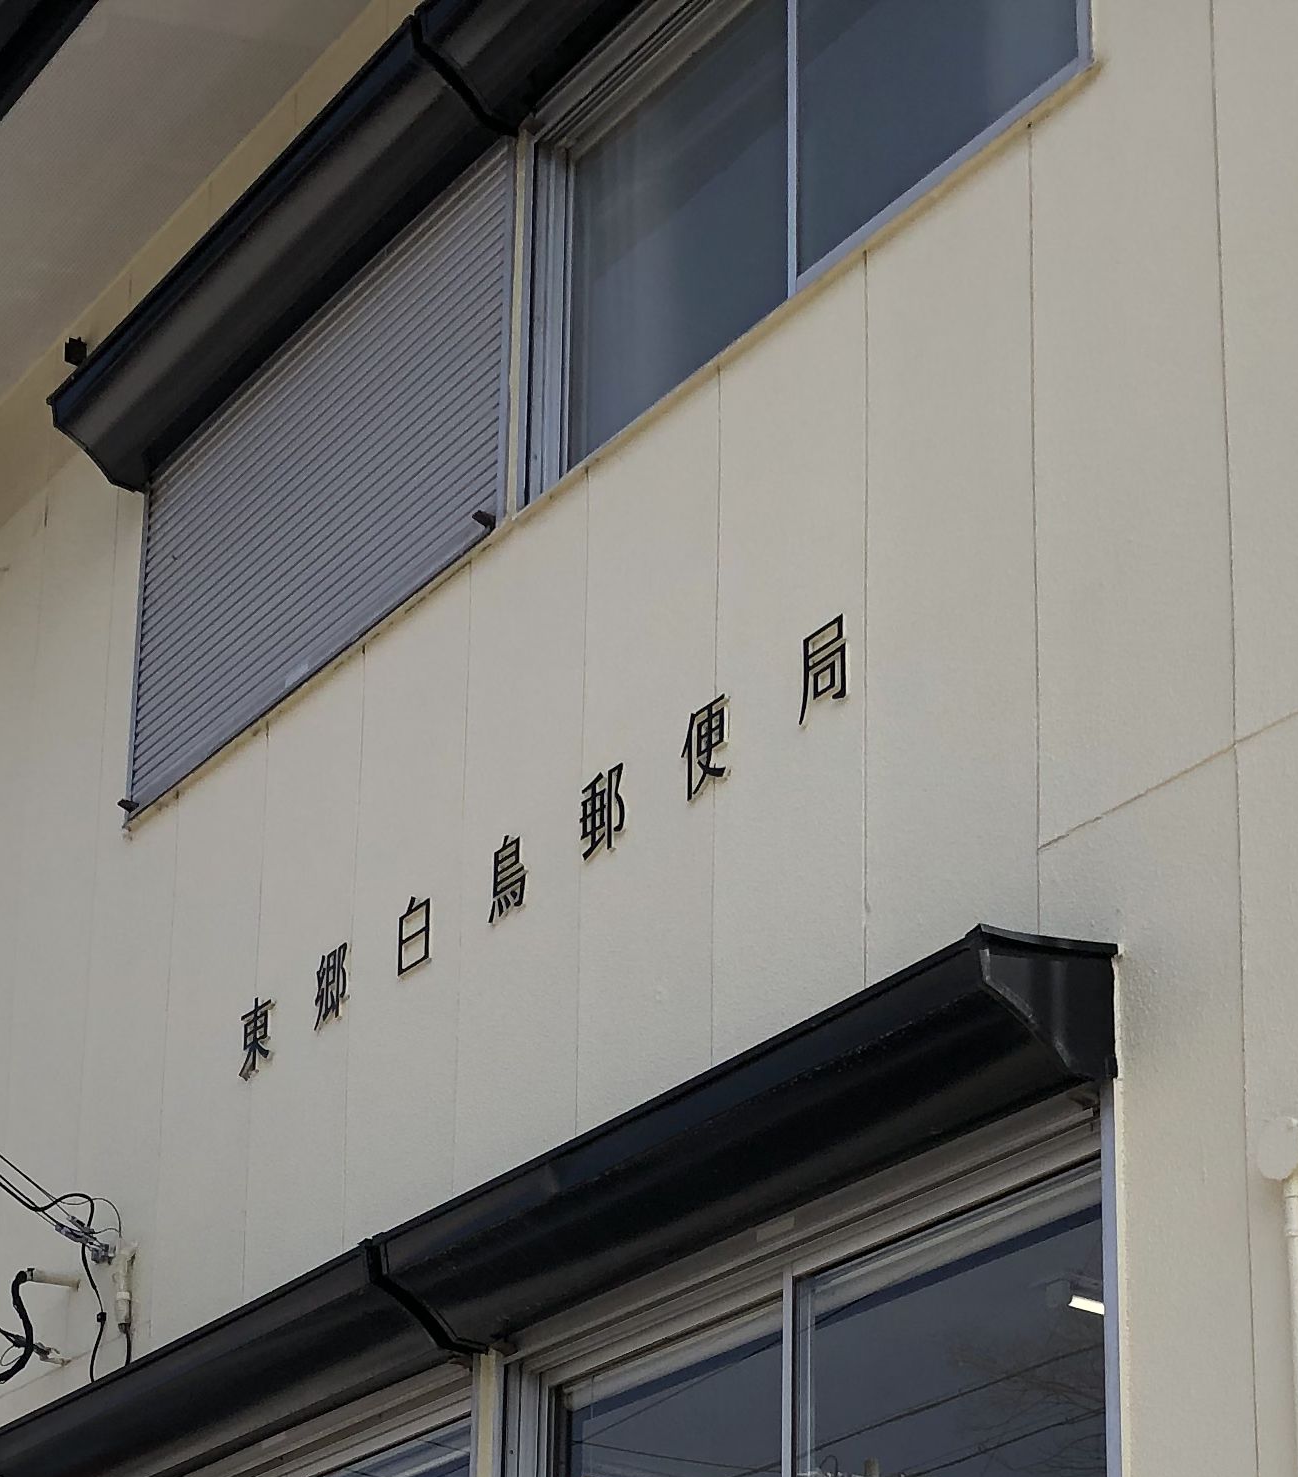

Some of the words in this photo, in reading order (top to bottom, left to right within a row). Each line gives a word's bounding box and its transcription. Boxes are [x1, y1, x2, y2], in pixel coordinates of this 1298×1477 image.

[239, 614, 850, 1082] 東郷白鳥郵便局
